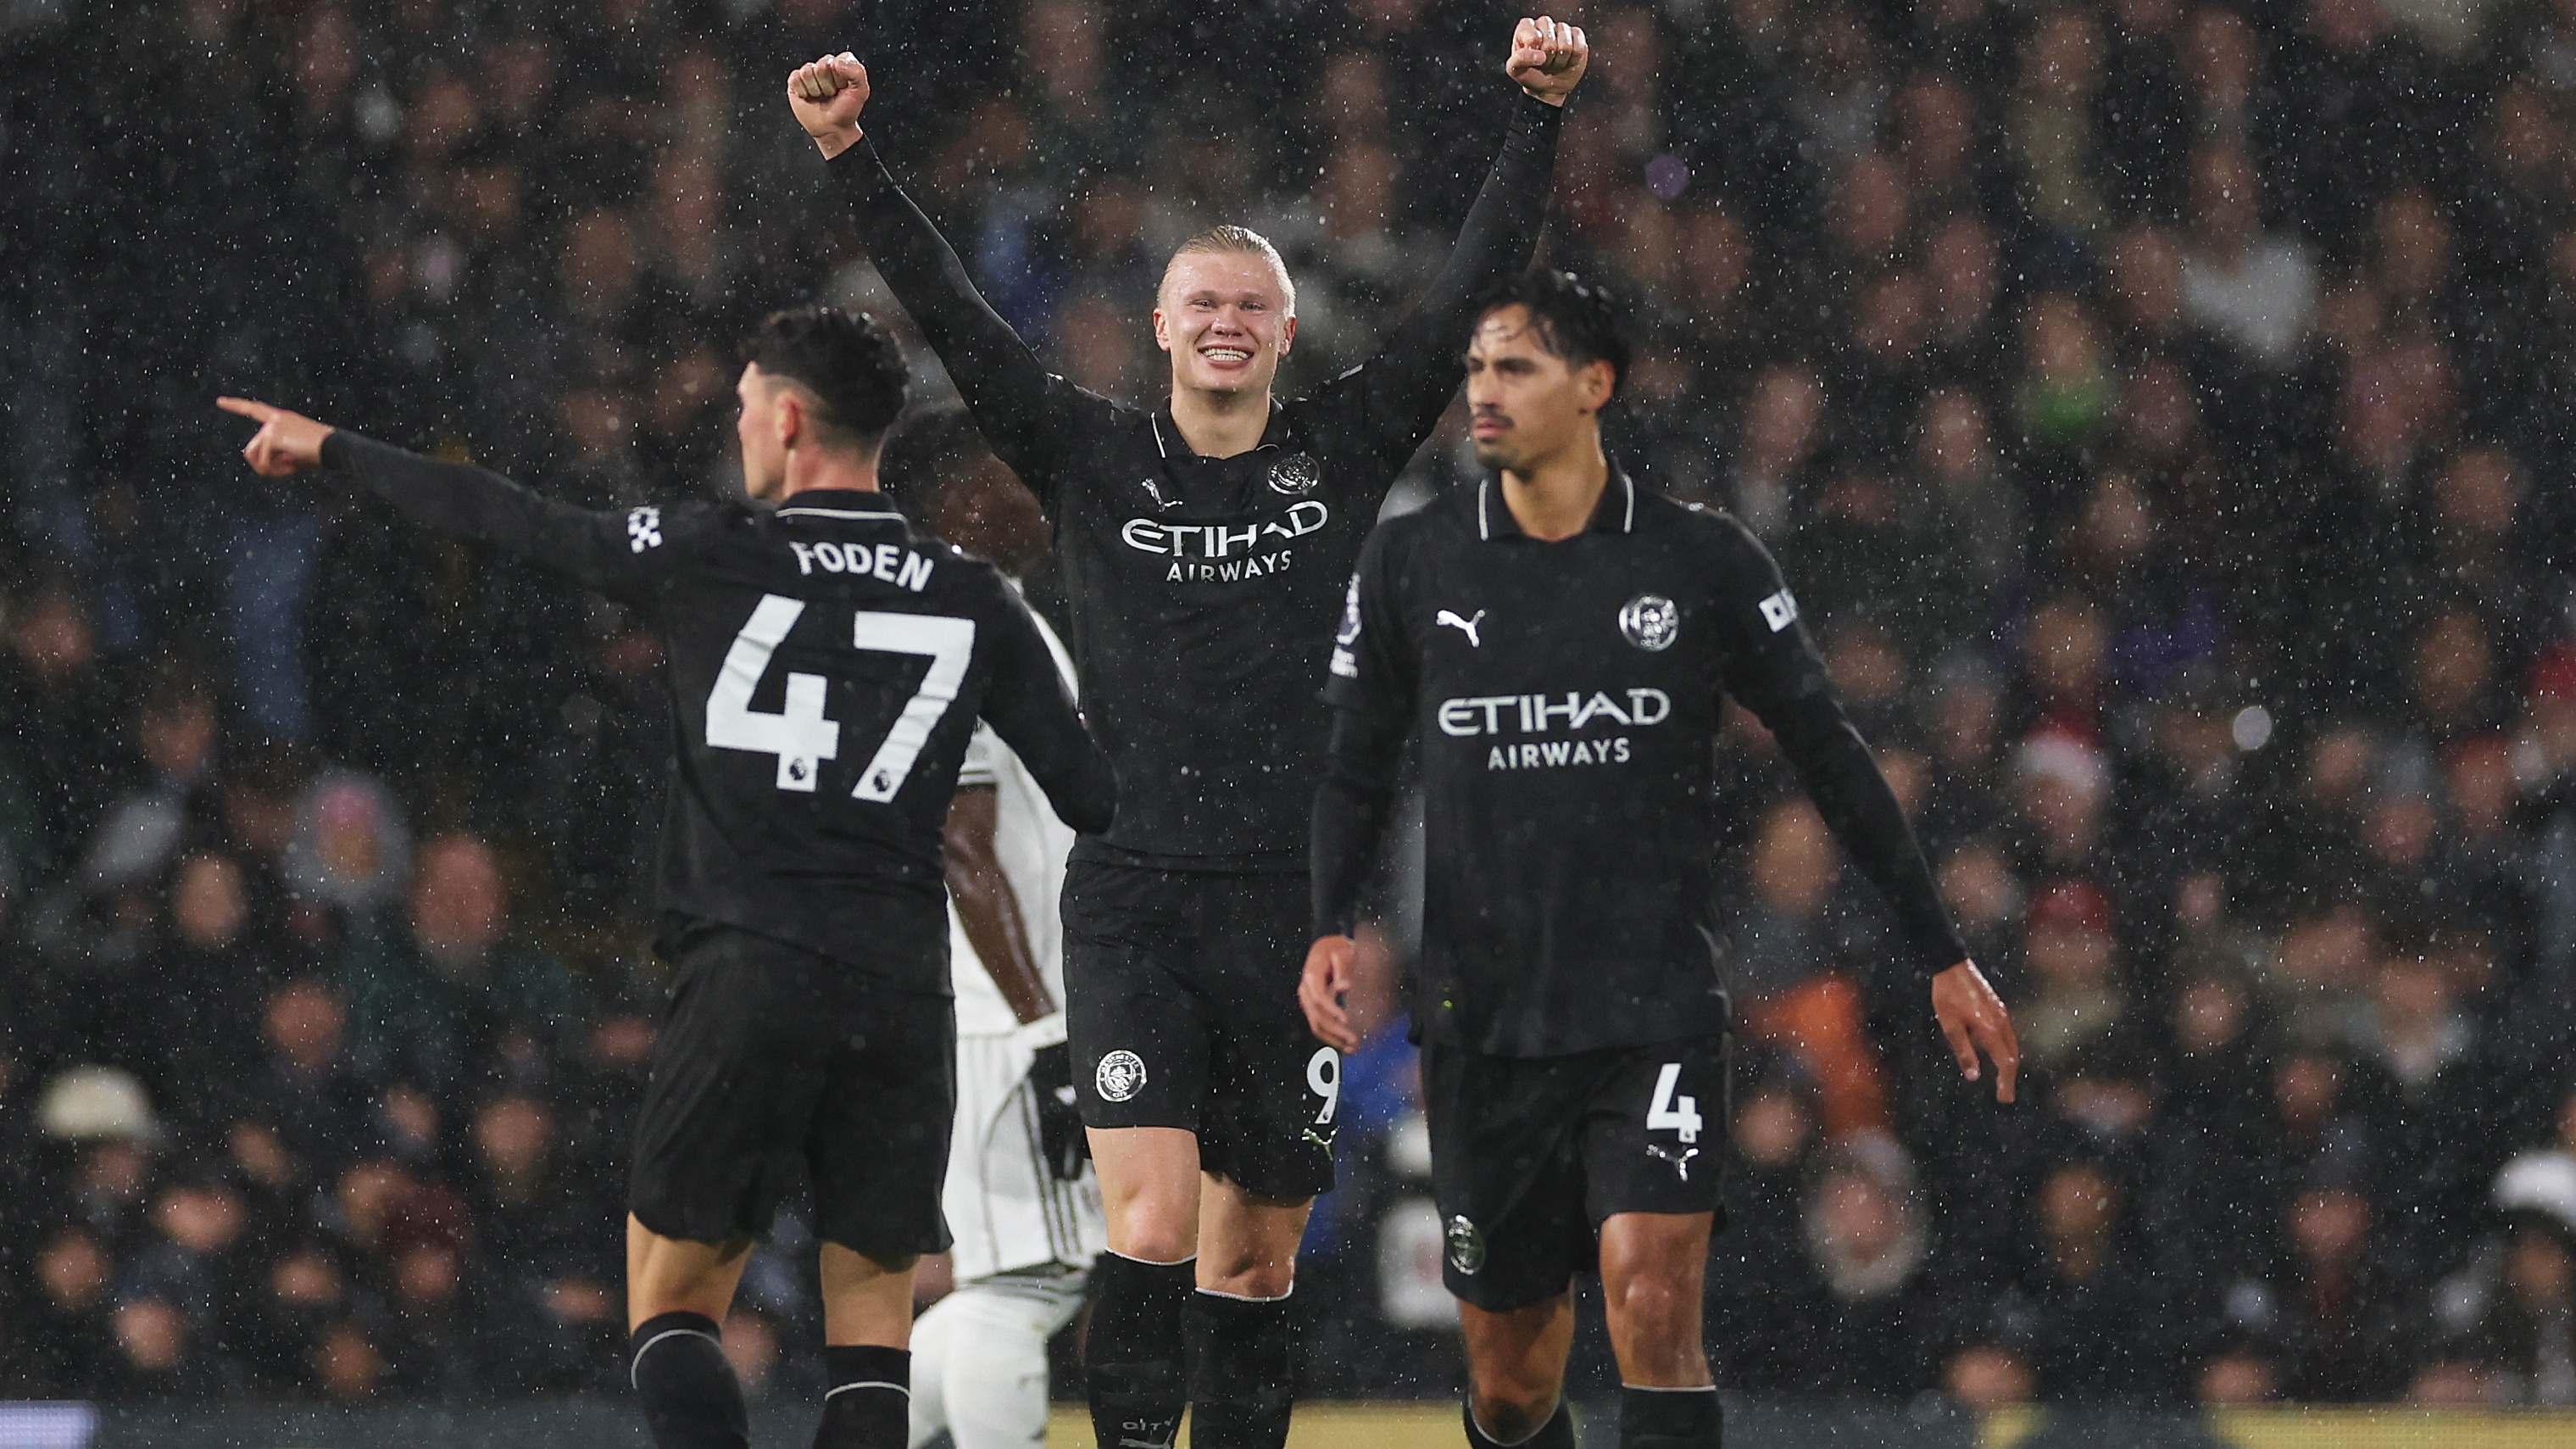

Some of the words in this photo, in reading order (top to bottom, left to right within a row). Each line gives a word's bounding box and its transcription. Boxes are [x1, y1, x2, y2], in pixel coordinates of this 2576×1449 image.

[789, 541, 935, 592] FODEN
[1166, 550, 1292, 582] AIRWAYS
[706, 594, 976, 803] 47
[1438, 688, 1670, 736] ETIHAD
[1487, 738, 1630, 771] AIRWAYS
[1306, 1046, 1340, 1123] 9
[1646, 1063, 1702, 1143] 4
